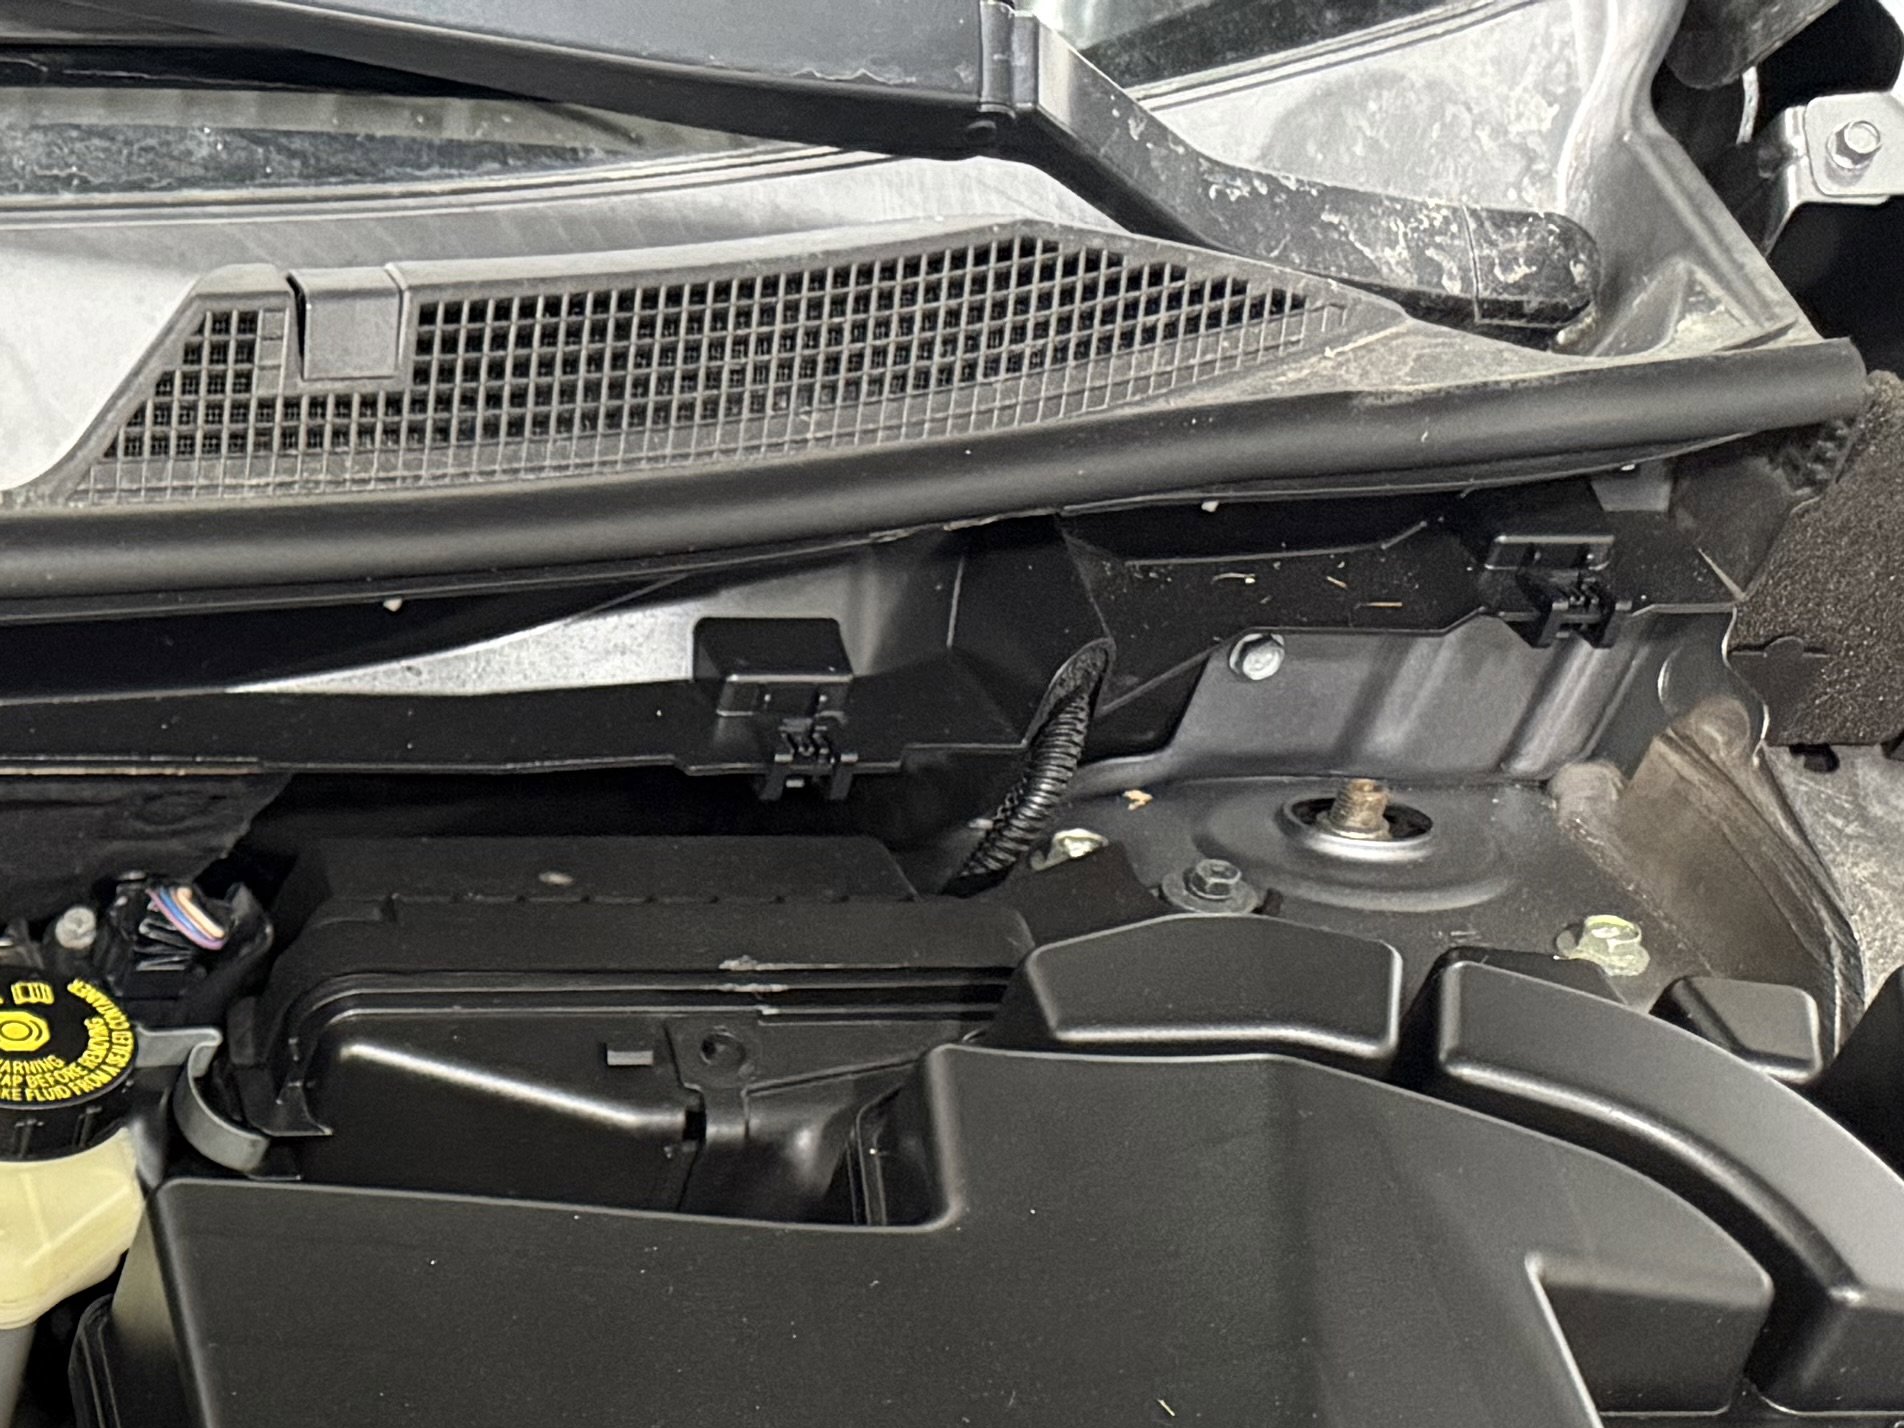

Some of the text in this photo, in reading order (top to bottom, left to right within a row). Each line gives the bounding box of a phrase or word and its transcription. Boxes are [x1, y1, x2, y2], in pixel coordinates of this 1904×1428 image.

[67, 978, 131, 1031] CONTAINER
[26, 1062, 87, 1089] BEFORE
[78, 1017, 109, 1070] REMOVING
[107, 1031, 134, 1068] SEALED
[25, 1085, 72, 1102] FLUID
[68, 1070, 113, 1096] FROM
